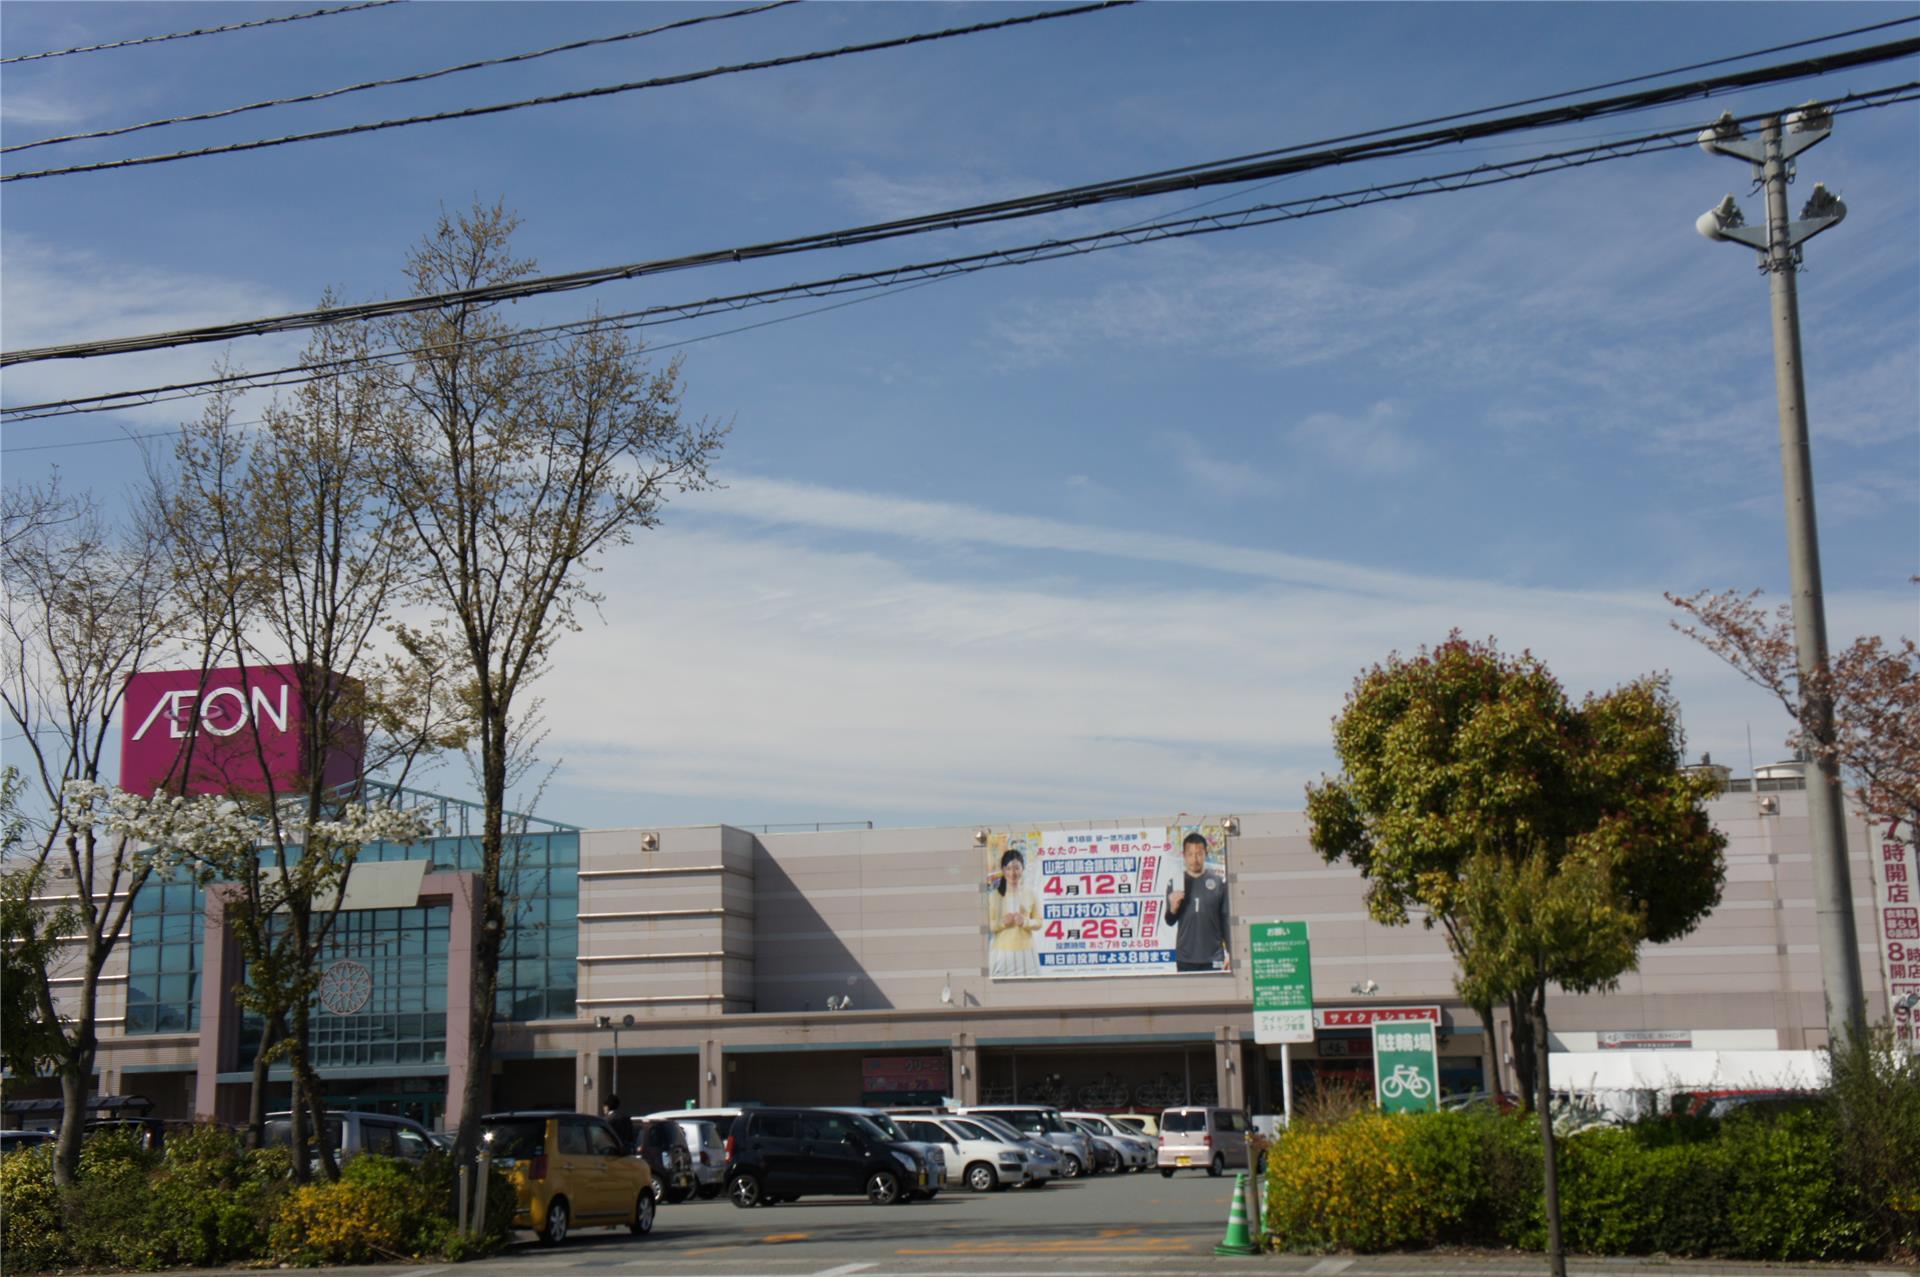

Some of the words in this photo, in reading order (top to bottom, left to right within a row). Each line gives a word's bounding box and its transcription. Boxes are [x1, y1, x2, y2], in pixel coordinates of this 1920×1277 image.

[1037, 845, 1098, 856] あなたの一票
[1110, 843, 1173, 853] 明日への一歩
[1140, 856, 1156, 893] 投票日
[1046, 902, 1135, 918] 市町村の選挙
[1141, 900, 1158, 938] 投票日
[1377, 1033, 1432, 1052] 駐輪場
